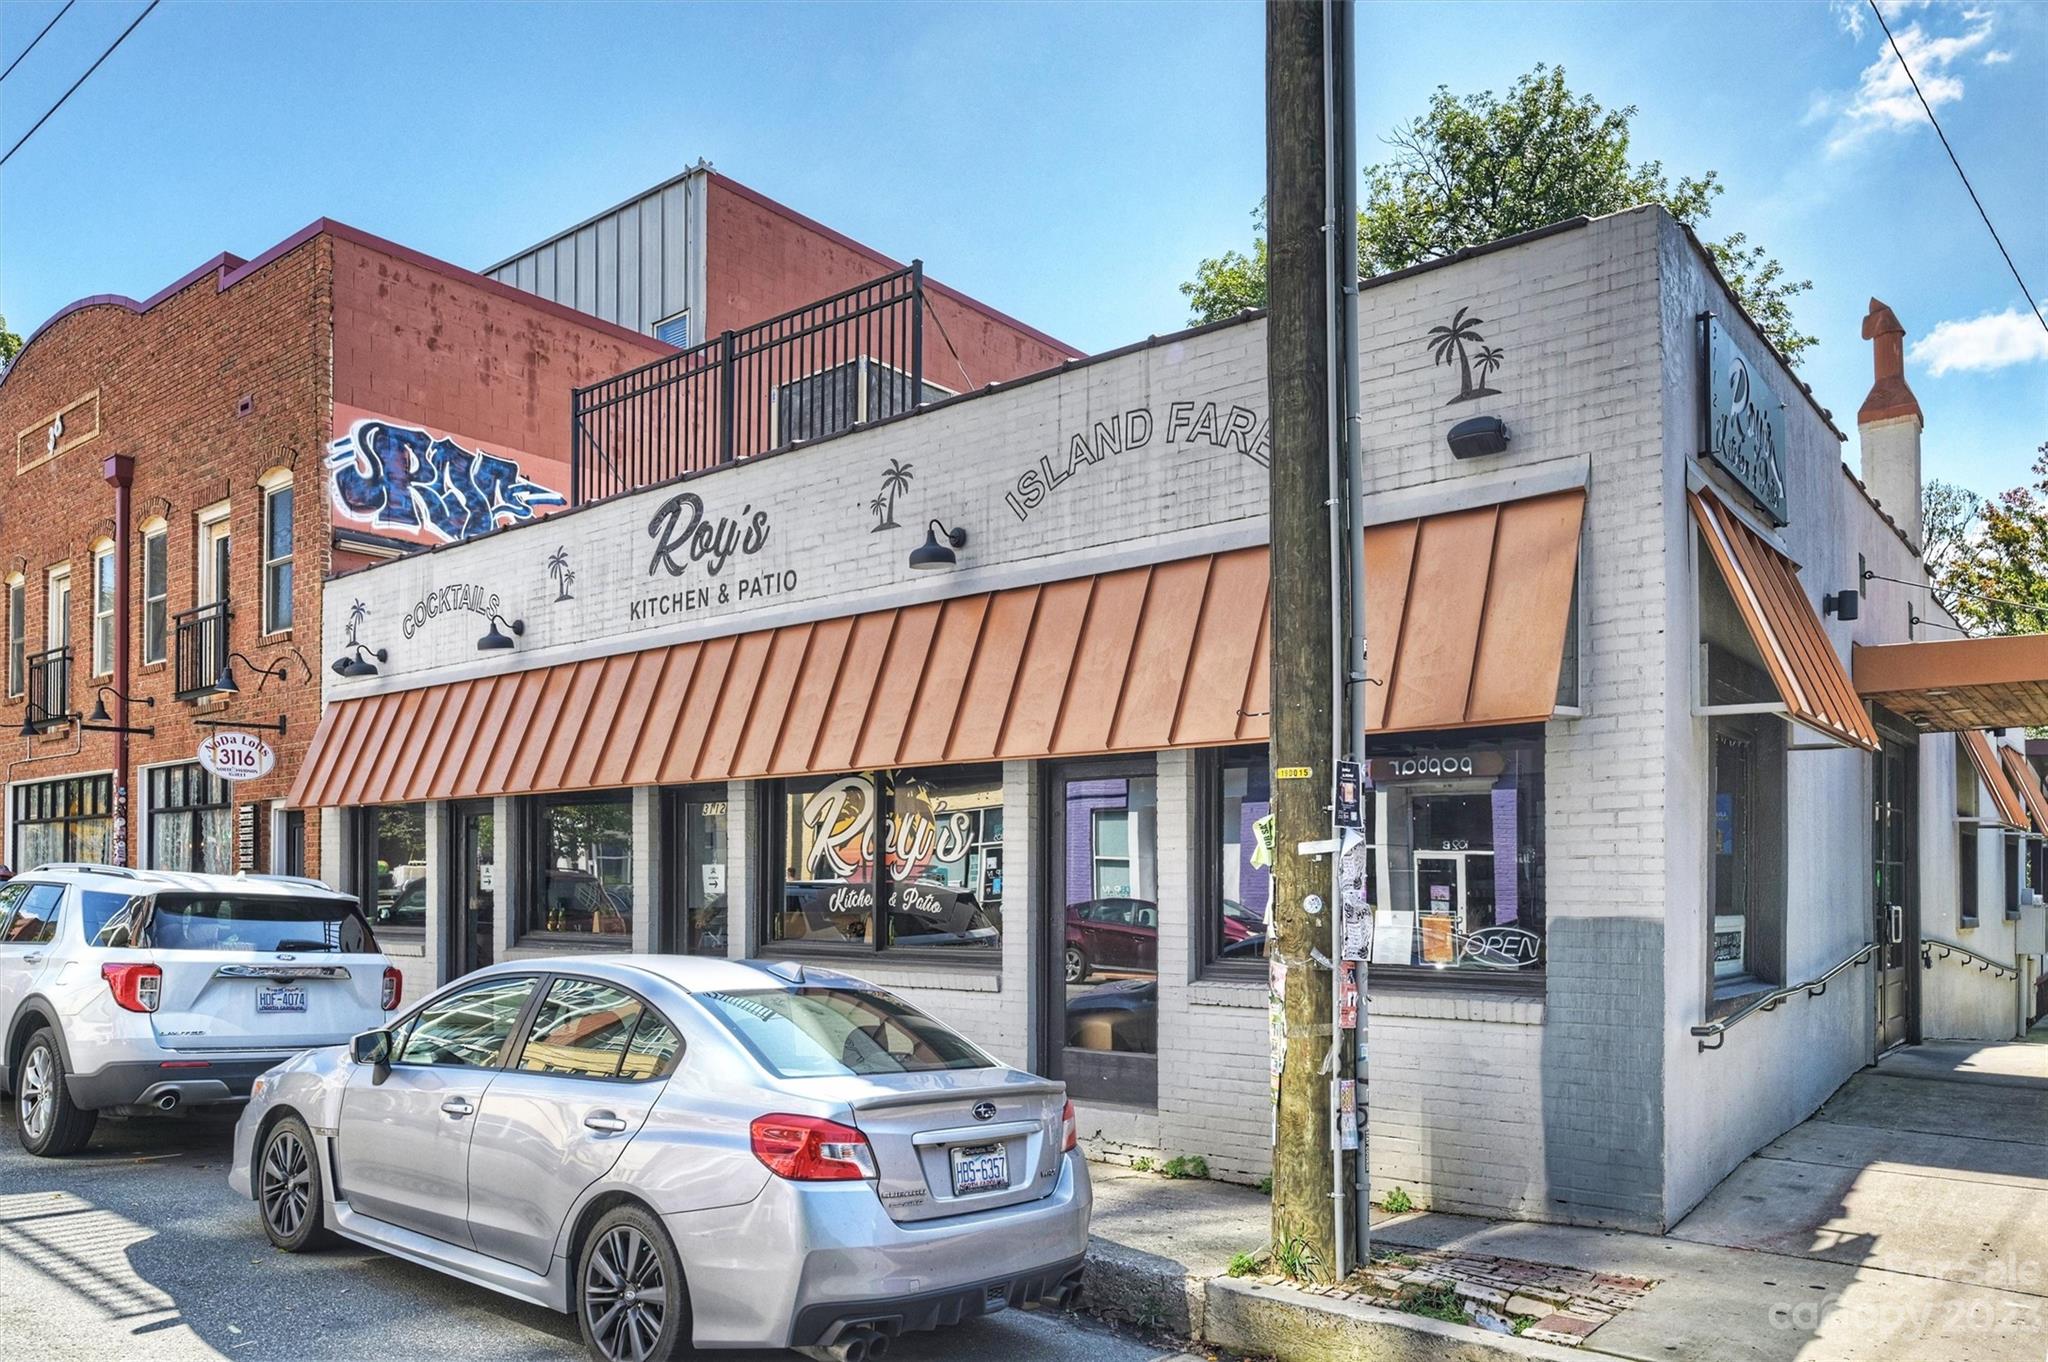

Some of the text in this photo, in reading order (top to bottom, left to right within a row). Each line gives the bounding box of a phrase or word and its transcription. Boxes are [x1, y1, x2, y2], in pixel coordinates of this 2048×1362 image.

[1005, 408, 1153, 522] ISLAND
[648, 492, 771, 577] Roy's
[630, 569, 798, 621] KITCHEN & PATIO
[402, 583, 501, 640] COCKTAILS
[219, 748, 256, 767] 3116
[704, 803, 728, 815] 3112
[829, 886, 942, 914] Kitche & Patio
[1465, 934, 1542, 959] OPEN
[956, 1157, 1005, 1184] HBS-6357
